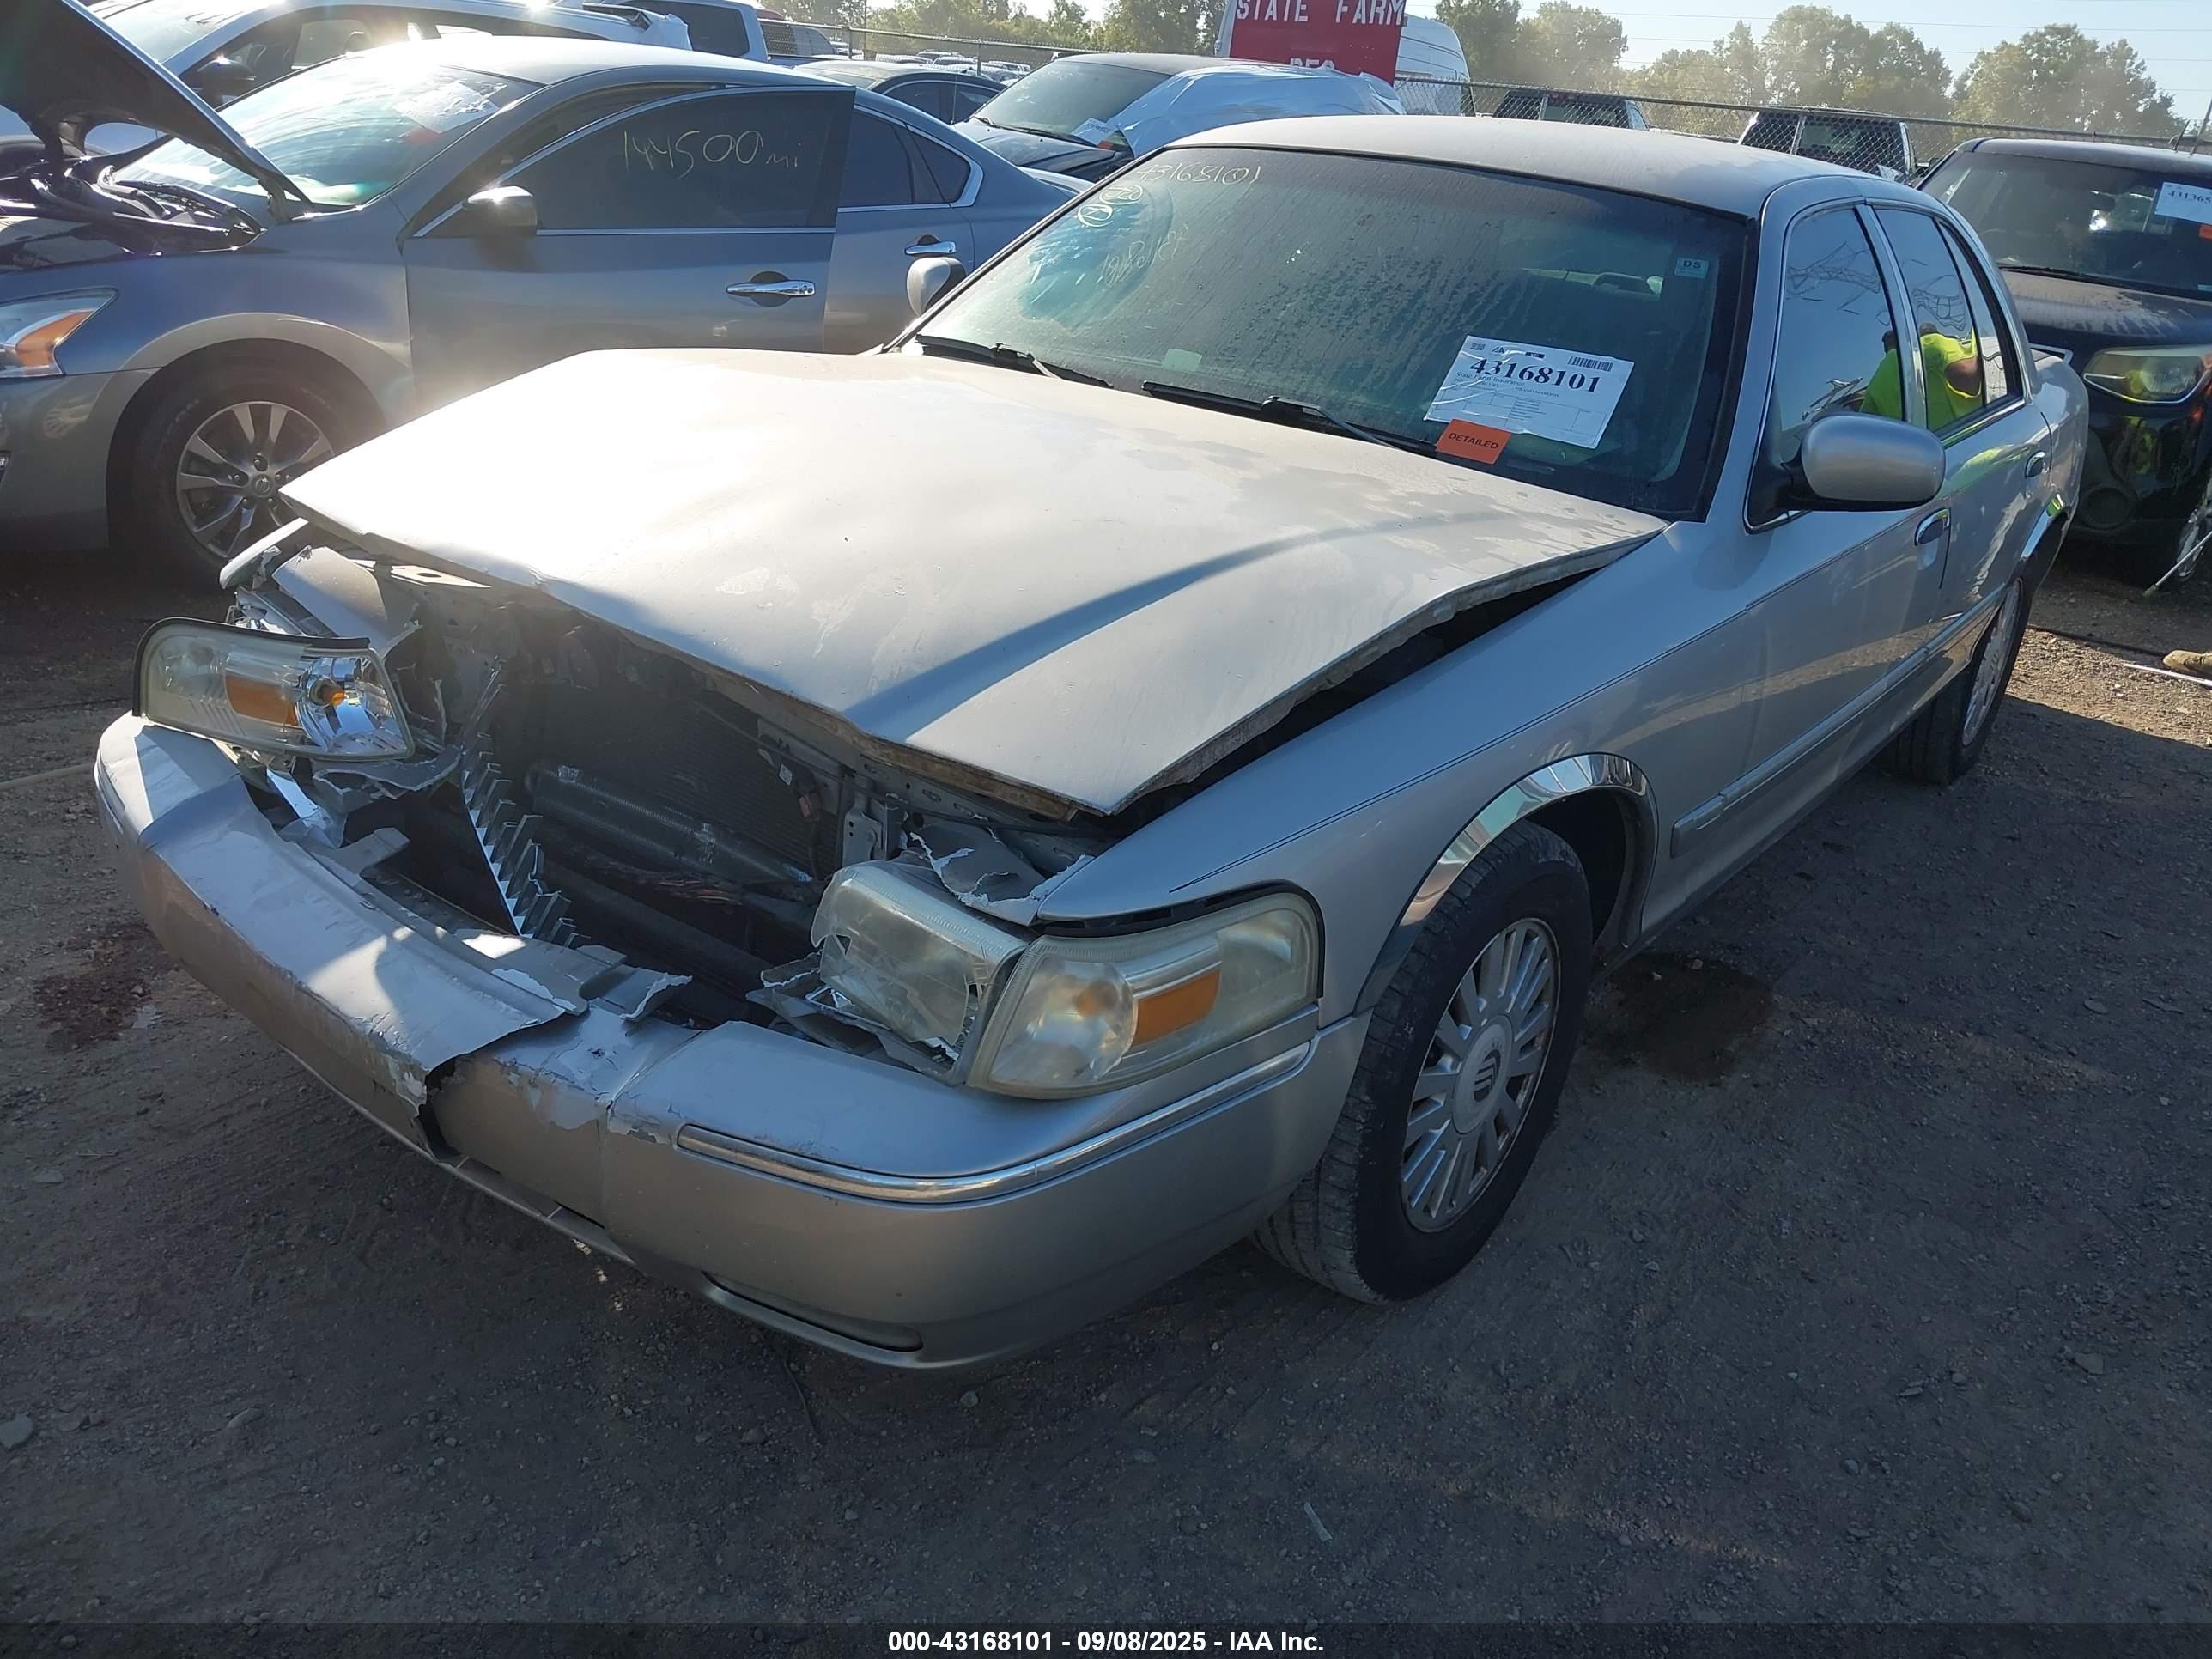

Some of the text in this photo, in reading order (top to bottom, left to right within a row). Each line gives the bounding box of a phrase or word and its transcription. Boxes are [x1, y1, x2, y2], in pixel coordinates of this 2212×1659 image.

[1236, 0, 1404, 25] STATE FARM
[1455, 371, 1475, 380] State
[1469, 358, 1602, 393] 43168101
[1448, 432, 1499, 450] DETAILED
